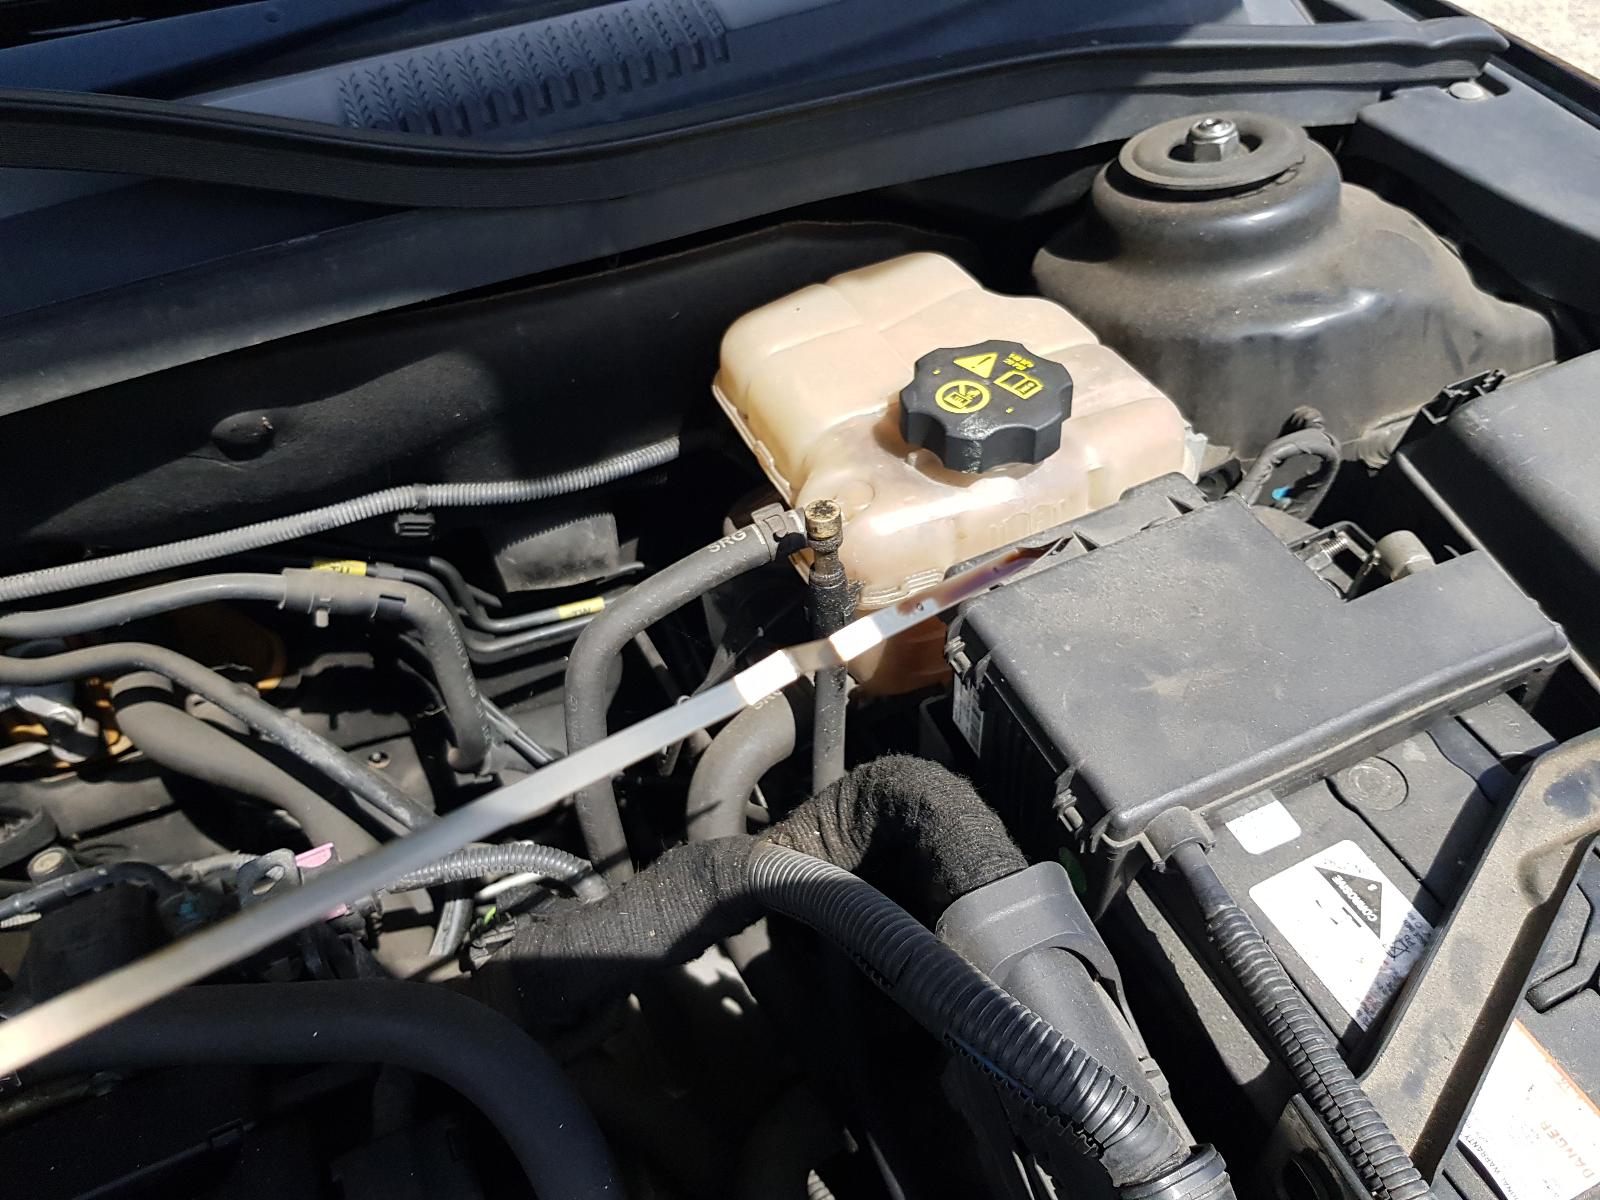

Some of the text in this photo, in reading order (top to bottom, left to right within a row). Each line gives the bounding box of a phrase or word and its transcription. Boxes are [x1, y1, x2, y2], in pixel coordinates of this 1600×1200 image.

[709, 530, 748, 553] SRG
[1331, 874, 1378, 922] CORROSIVE
[1465, 1135, 1501, 1174] WARRANTY
[1539, 1120, 1595, 1179] DANGER
